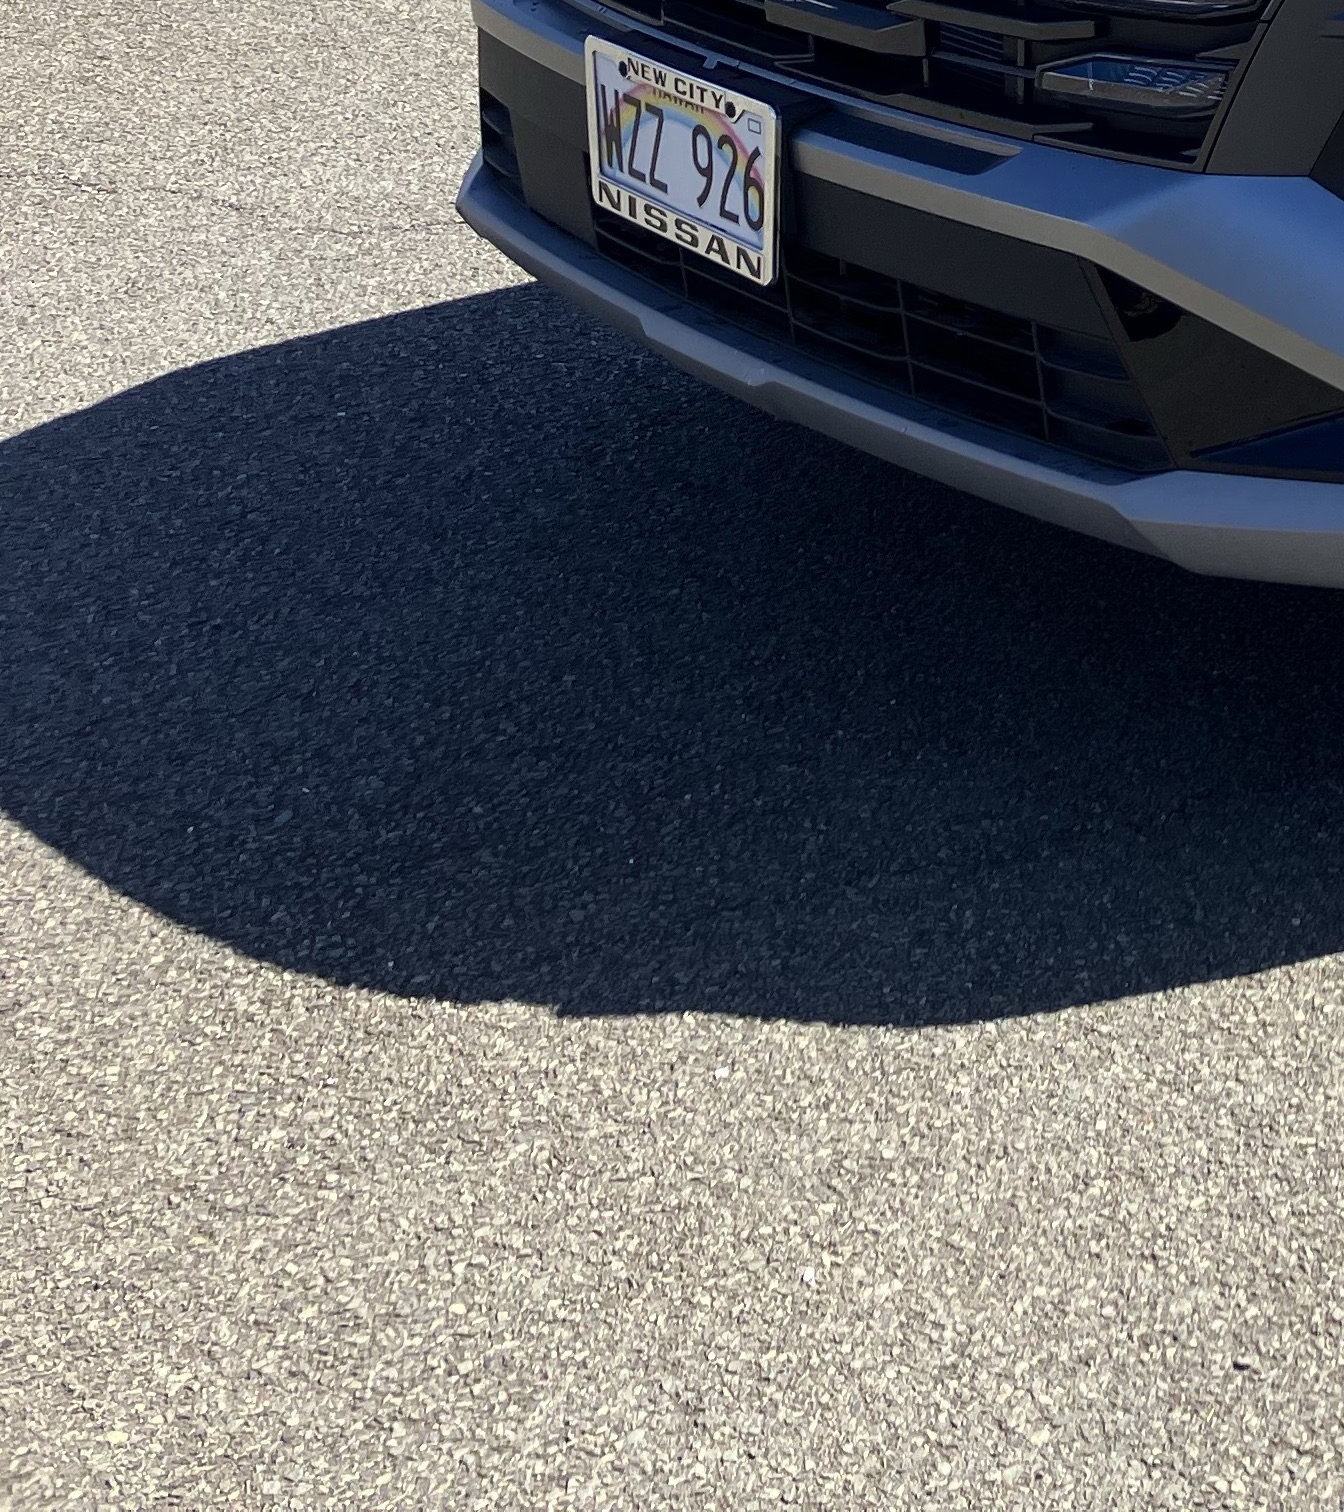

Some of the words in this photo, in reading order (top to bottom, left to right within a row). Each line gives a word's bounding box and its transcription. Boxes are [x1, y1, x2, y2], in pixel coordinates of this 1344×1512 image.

[627, 57, 667, 88] NEW
[674, 77, 725, 109] CITY
[601, 85, 668, 194] WZZ
[691, 124, 765, 232] 926
[599, 180, 762, 280] NISSAN
